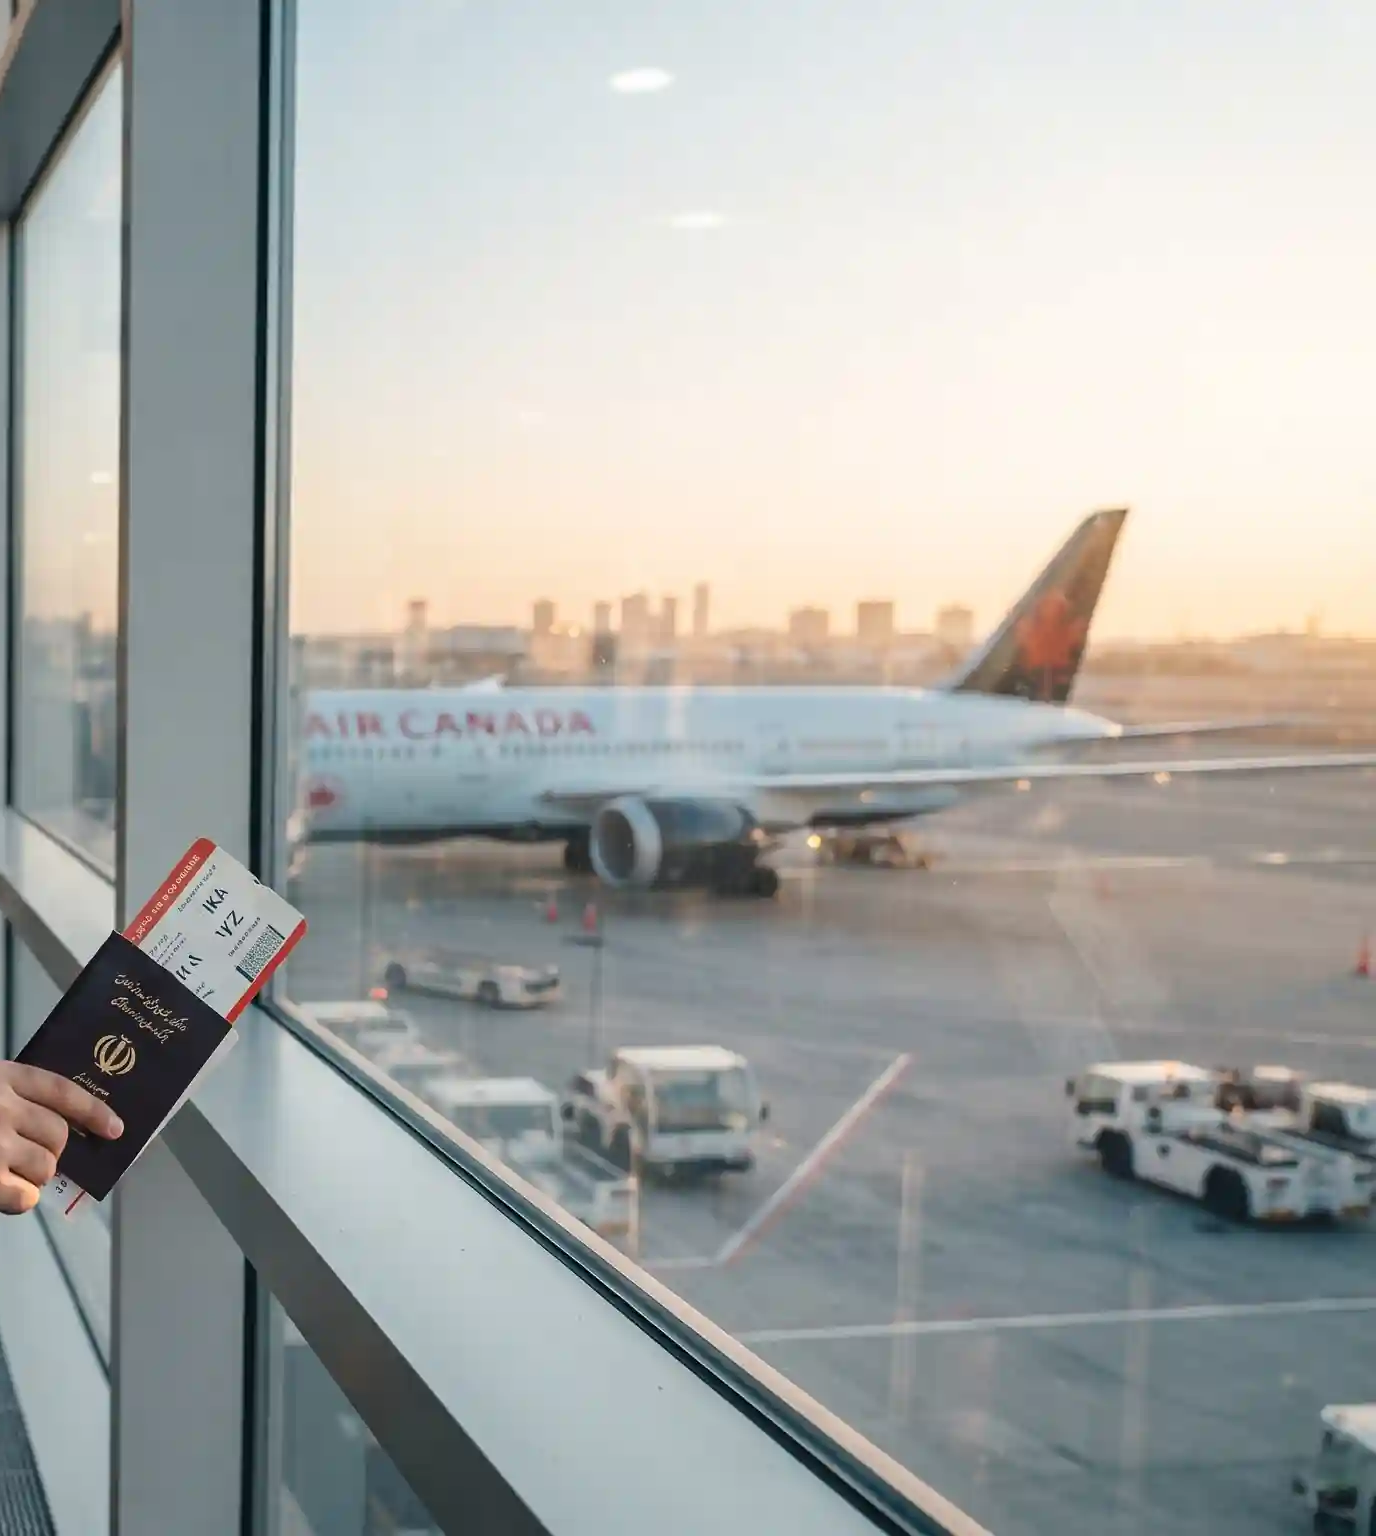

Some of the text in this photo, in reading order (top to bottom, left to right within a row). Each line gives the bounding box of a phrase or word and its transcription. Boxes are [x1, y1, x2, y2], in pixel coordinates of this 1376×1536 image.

[304, 708, 596, 740] AIR CANADA
[202, 888, 229, 914] IKA
